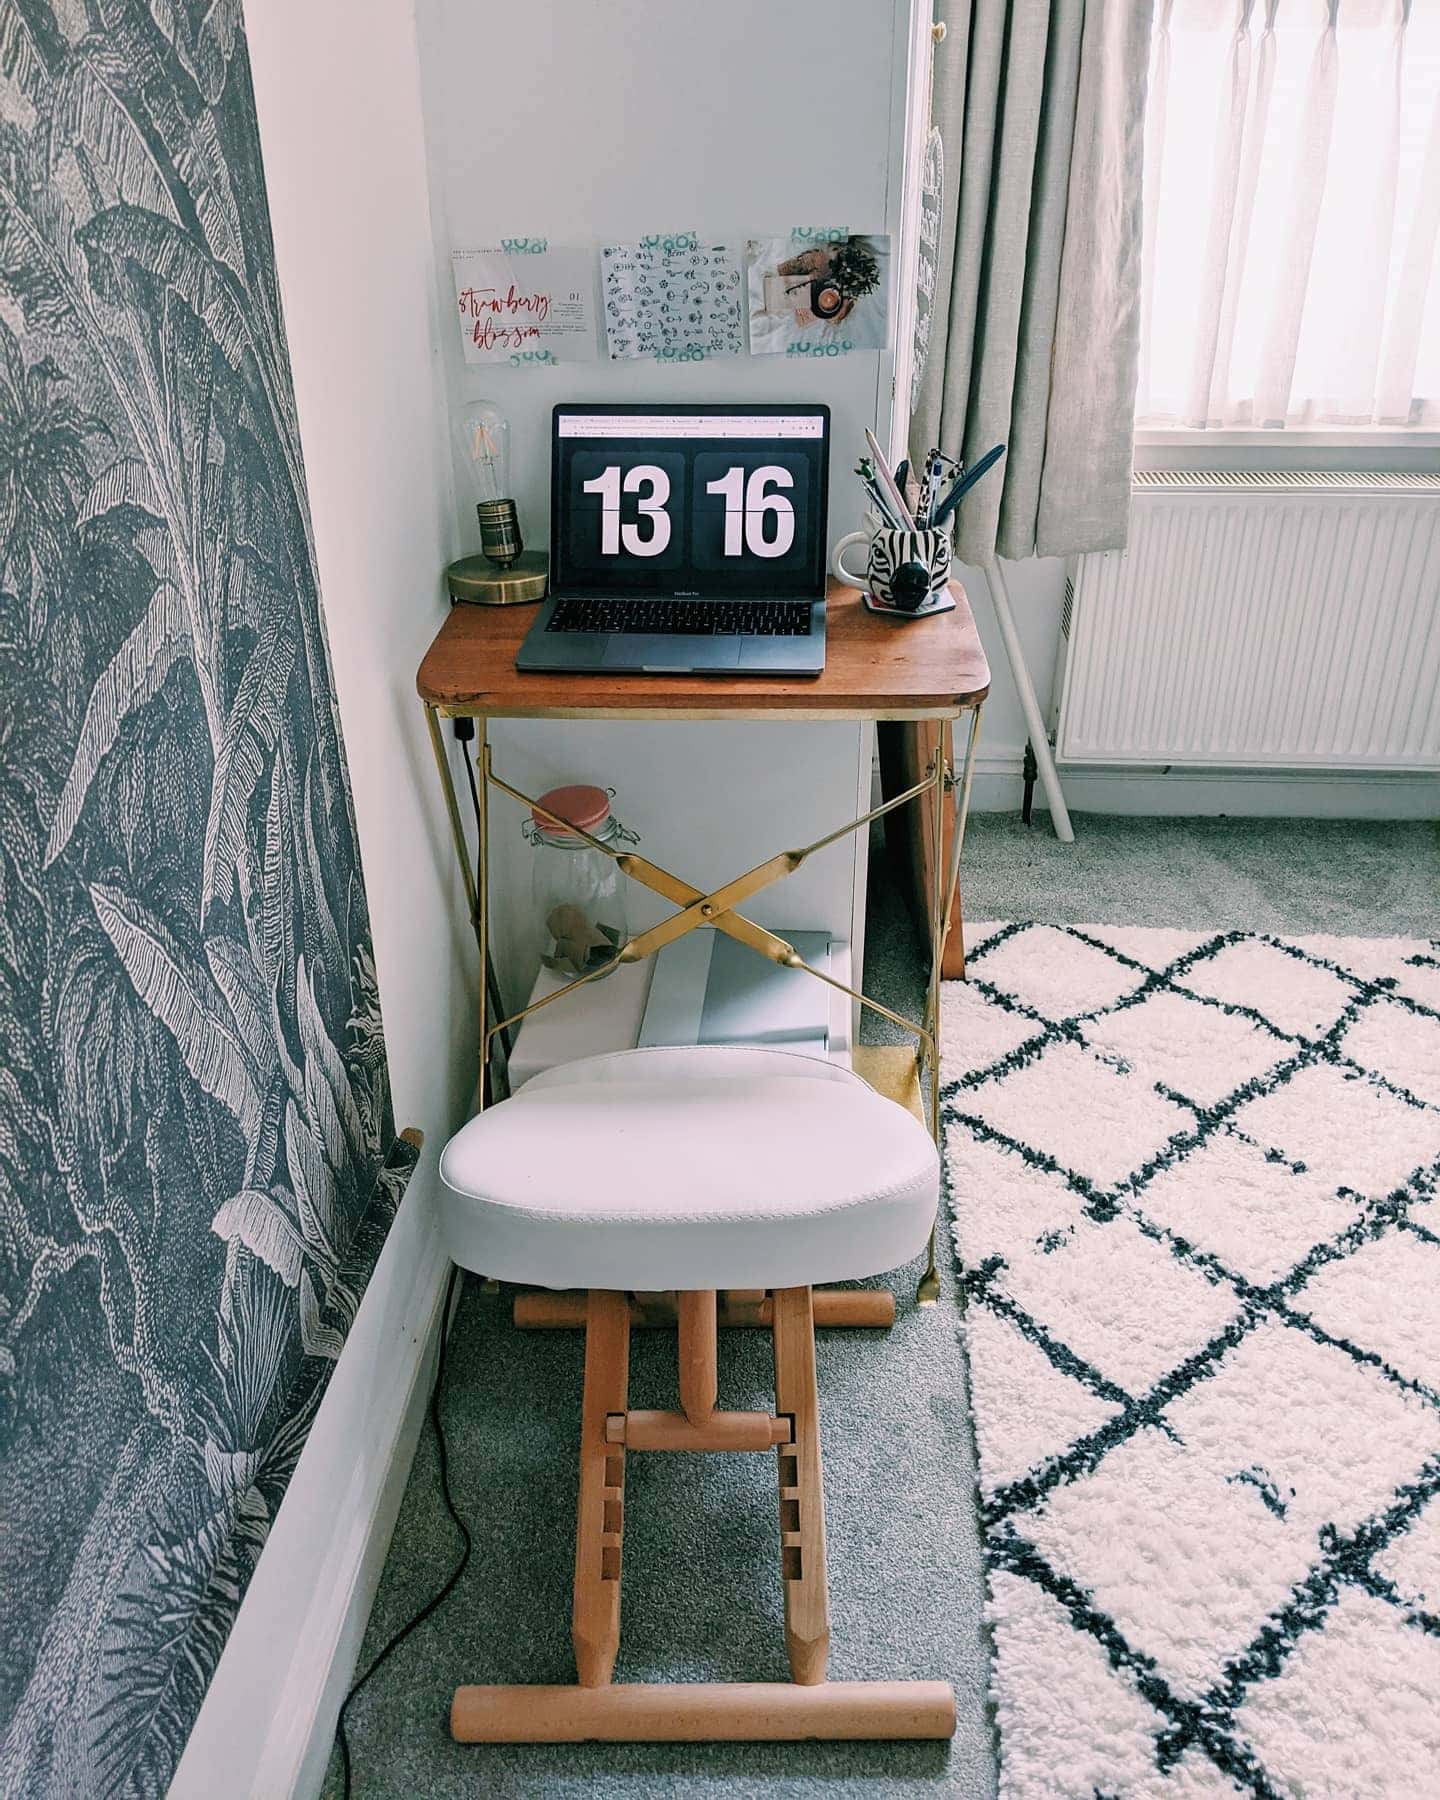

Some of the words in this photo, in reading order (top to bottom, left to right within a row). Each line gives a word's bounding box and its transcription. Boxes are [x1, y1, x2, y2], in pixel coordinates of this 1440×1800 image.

[458, 285, 548, 321] strawberry
[473, 317, 540, 349] blossom
[583, 465, 671, 557] 13
[706, 465, 795, 558] 16
